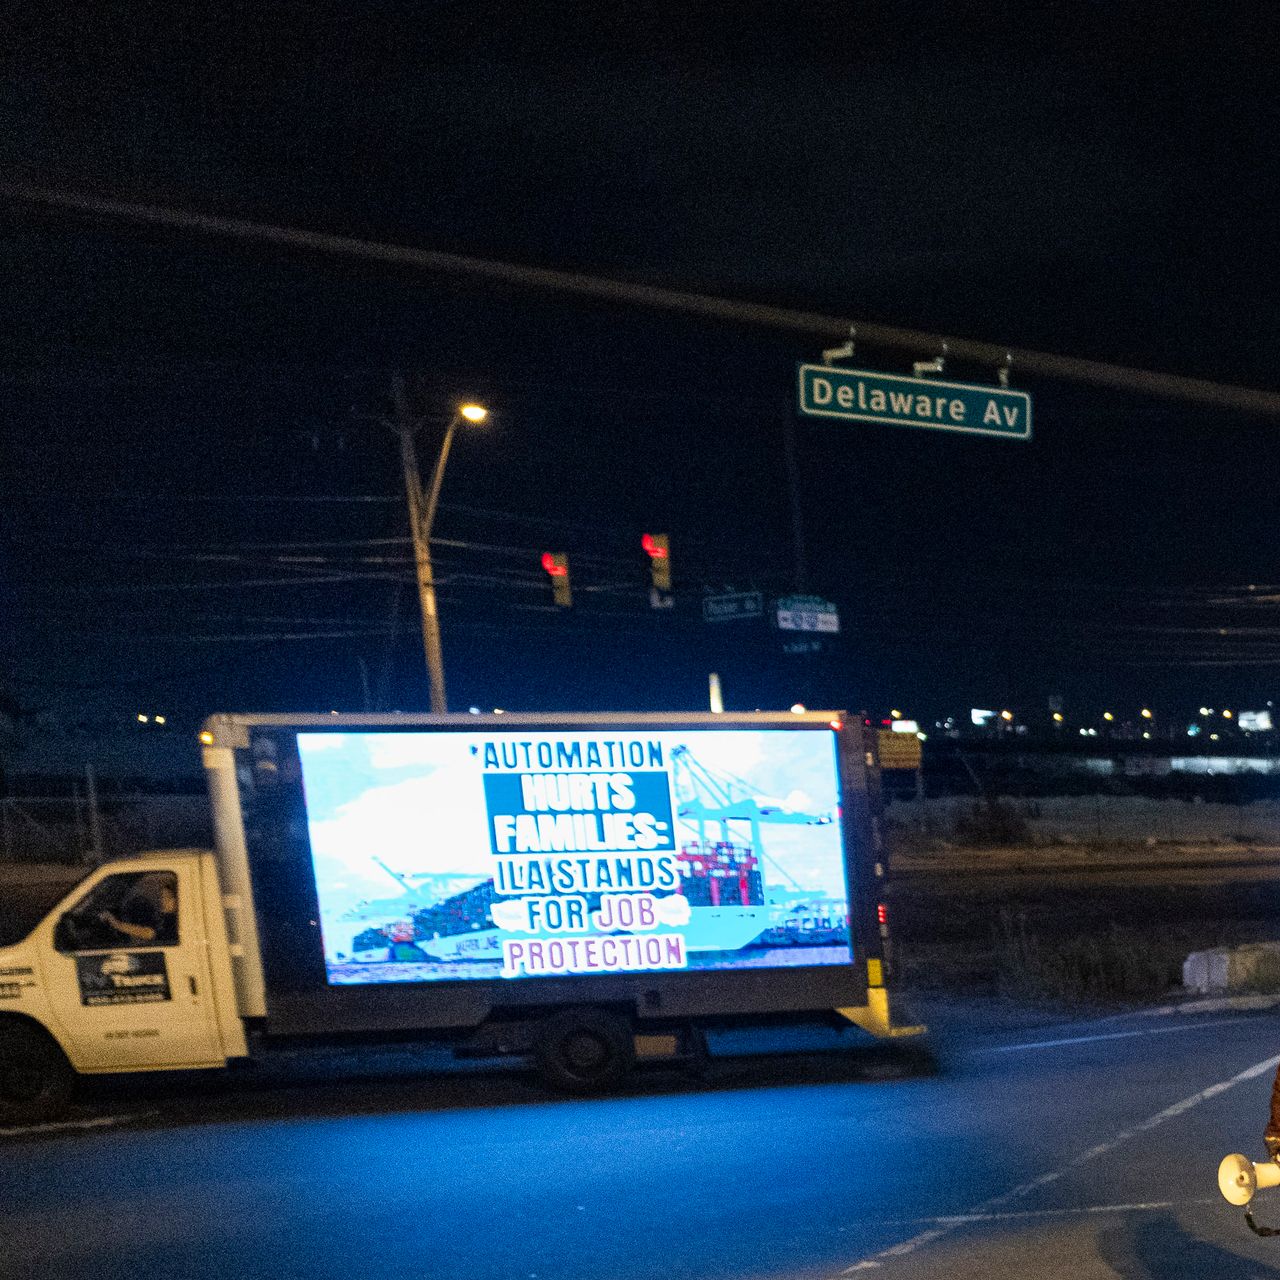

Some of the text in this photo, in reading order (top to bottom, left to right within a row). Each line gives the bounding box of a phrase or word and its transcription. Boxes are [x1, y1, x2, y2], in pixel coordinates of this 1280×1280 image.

[812, 378, 1019, 428] Delaware Av
[484, 741, 664, 769] AUTOMATION
[521, 773, 636, 811] HURTS
[494, 812, 670, 852] FAMILIES:
[497, 857, 676, 890] ILA STANDS
[527, 898, 656, 929] FOR JOB
[509, 937, 682, 970] PROTECTION
